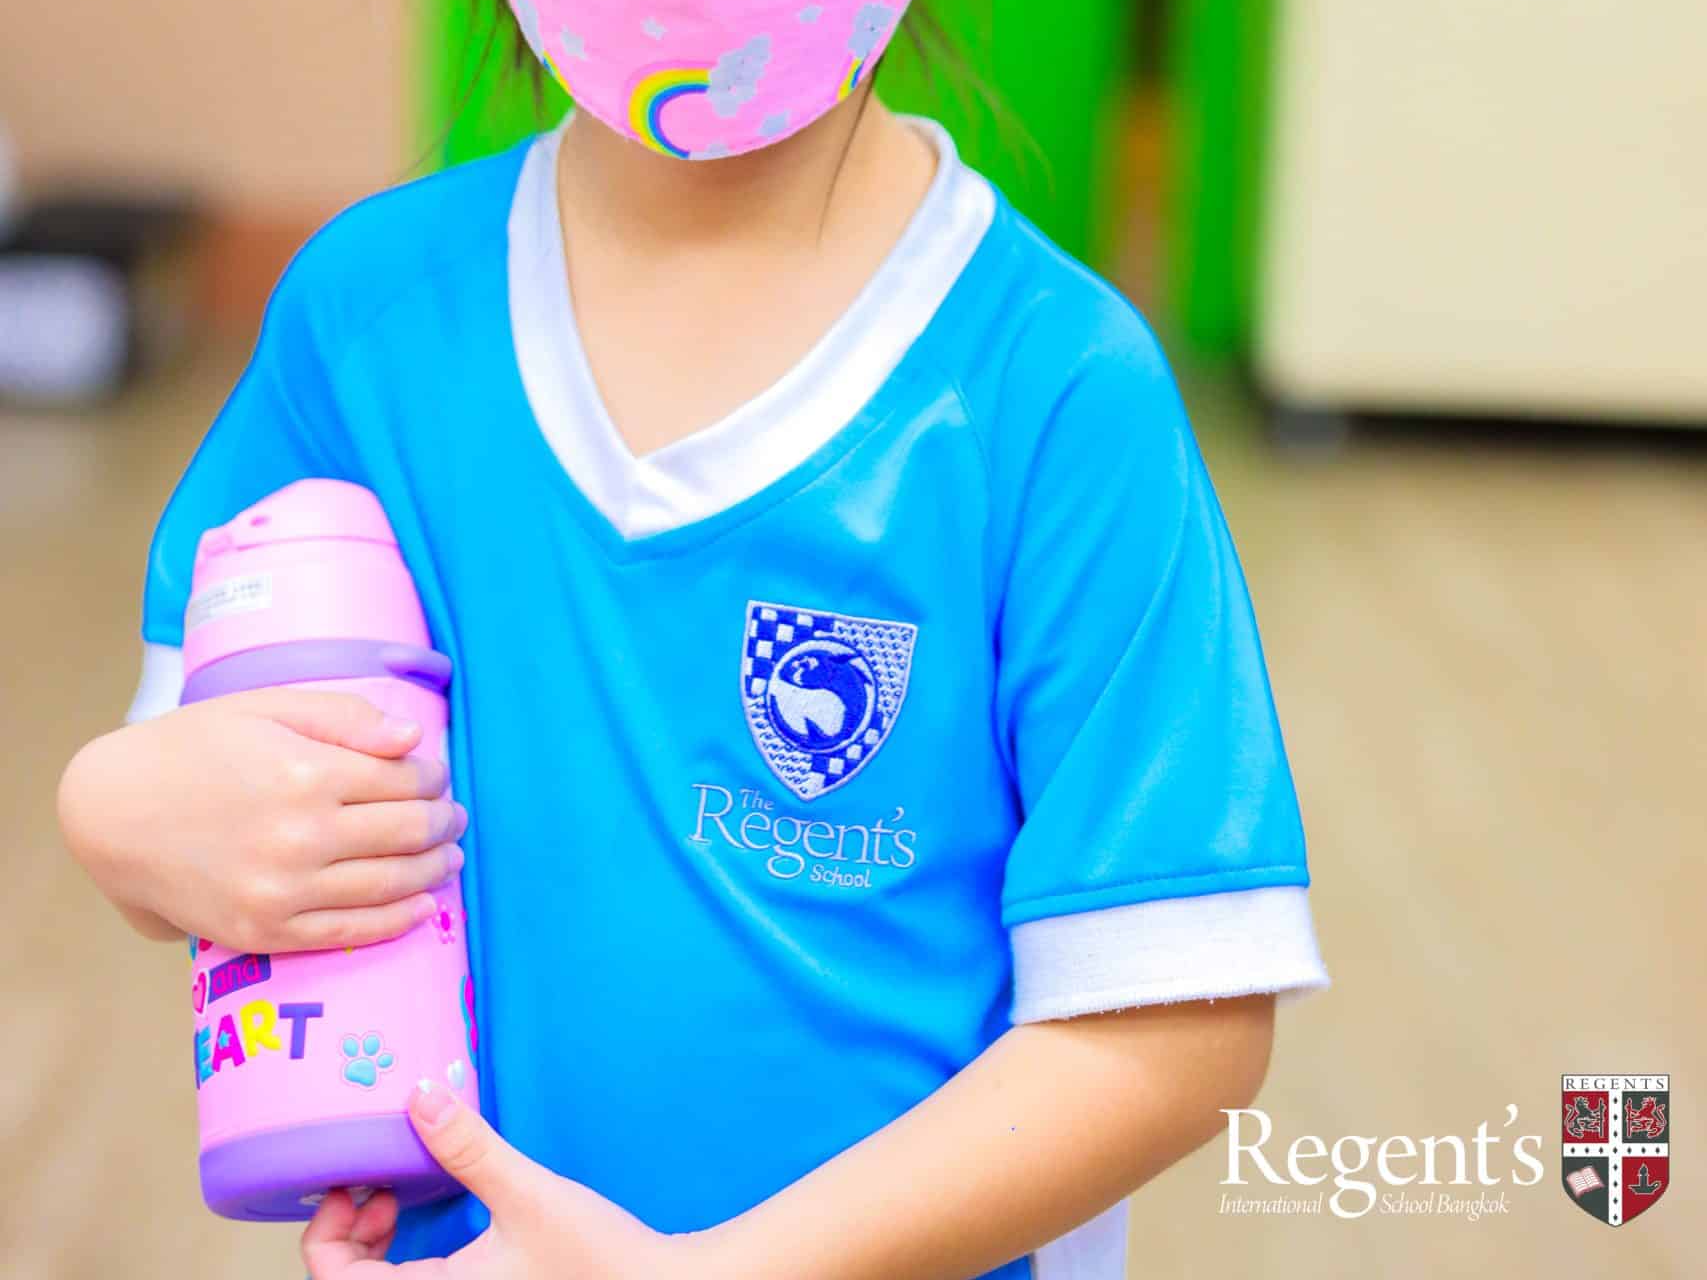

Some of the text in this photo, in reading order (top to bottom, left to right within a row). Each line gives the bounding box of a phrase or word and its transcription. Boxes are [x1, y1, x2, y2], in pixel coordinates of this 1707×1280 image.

[740, 788, 775, 811] The
[689, 783, 917, 879] Regent's
[809, 864, 872, 889] School
[212, 956, 263, 996] and
[194, 999, 324, 1090] EART
